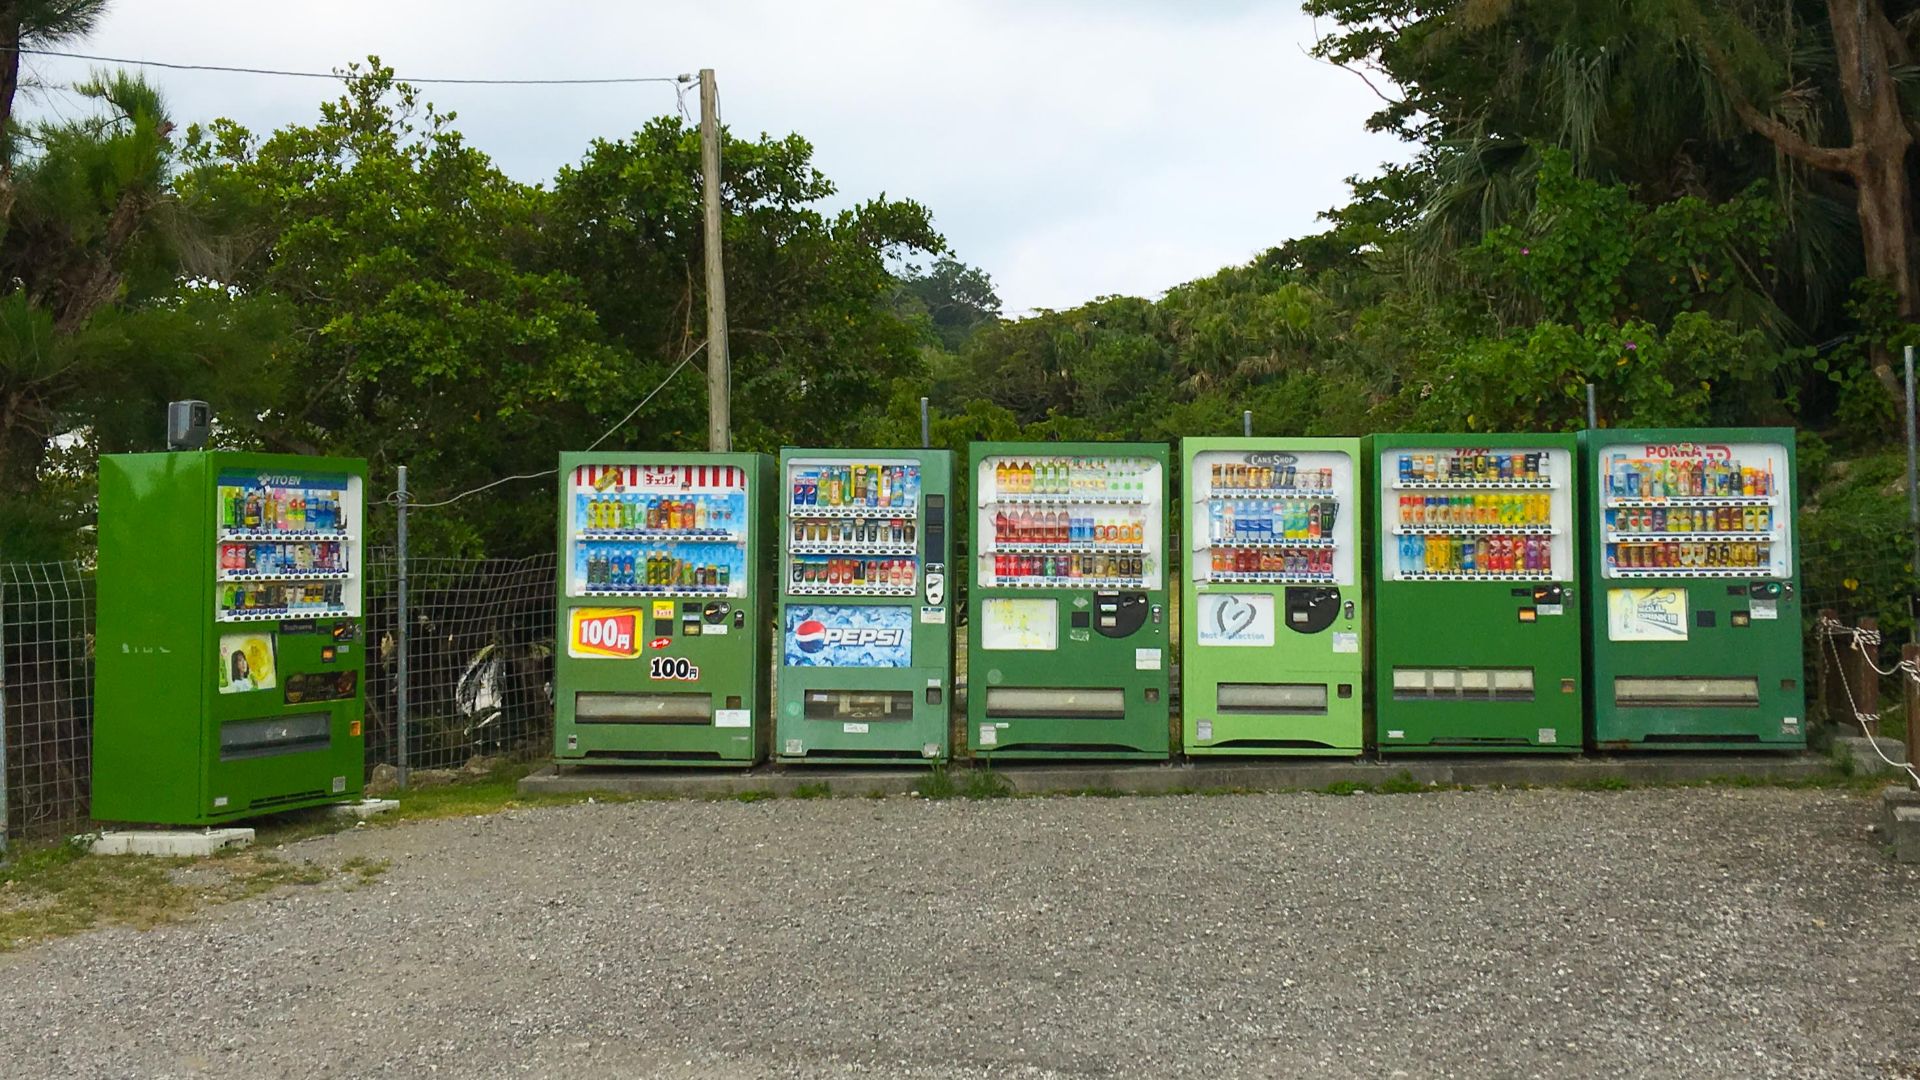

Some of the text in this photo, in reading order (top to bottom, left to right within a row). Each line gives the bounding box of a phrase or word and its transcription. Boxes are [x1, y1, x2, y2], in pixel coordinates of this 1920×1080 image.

[271, 475, 301, 485] ITO EN
[645, 473, 676, 485] チェリオ
[580, 618, 630, 650] 100円
[823, 628, 904, 647] PEPSI
[650, 657, 699, 679] 100円
